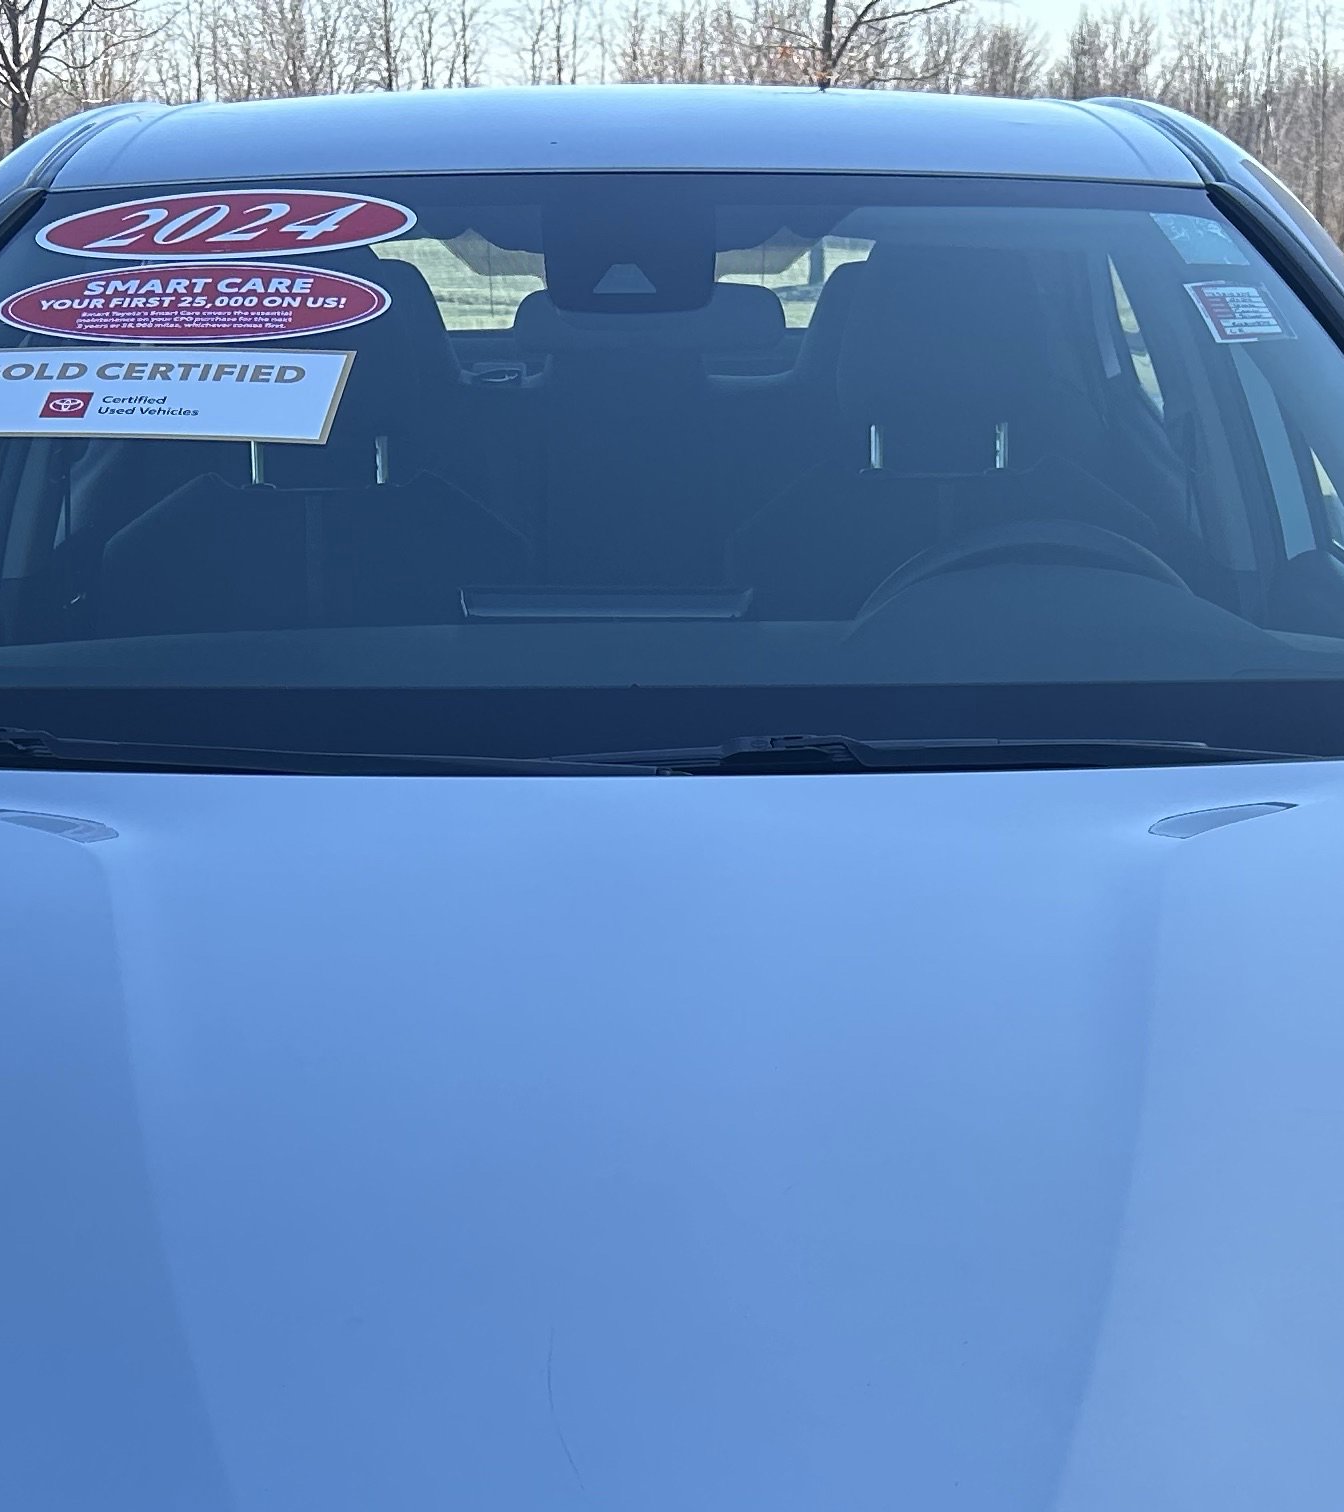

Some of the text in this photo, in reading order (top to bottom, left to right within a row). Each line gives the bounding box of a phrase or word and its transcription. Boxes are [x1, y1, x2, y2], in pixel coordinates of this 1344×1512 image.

[82, 202, 367, 249] 2024
[83, 277, 315, 296] SMART CARE
[39, 296, 348, 311] YOUR FIRST 25,000 ON US!
[95, 362, 307, 384] CERTIFIED
[102, 395, 167, 406] Certified
[97, 406, 200, 417] Used Vehicles
